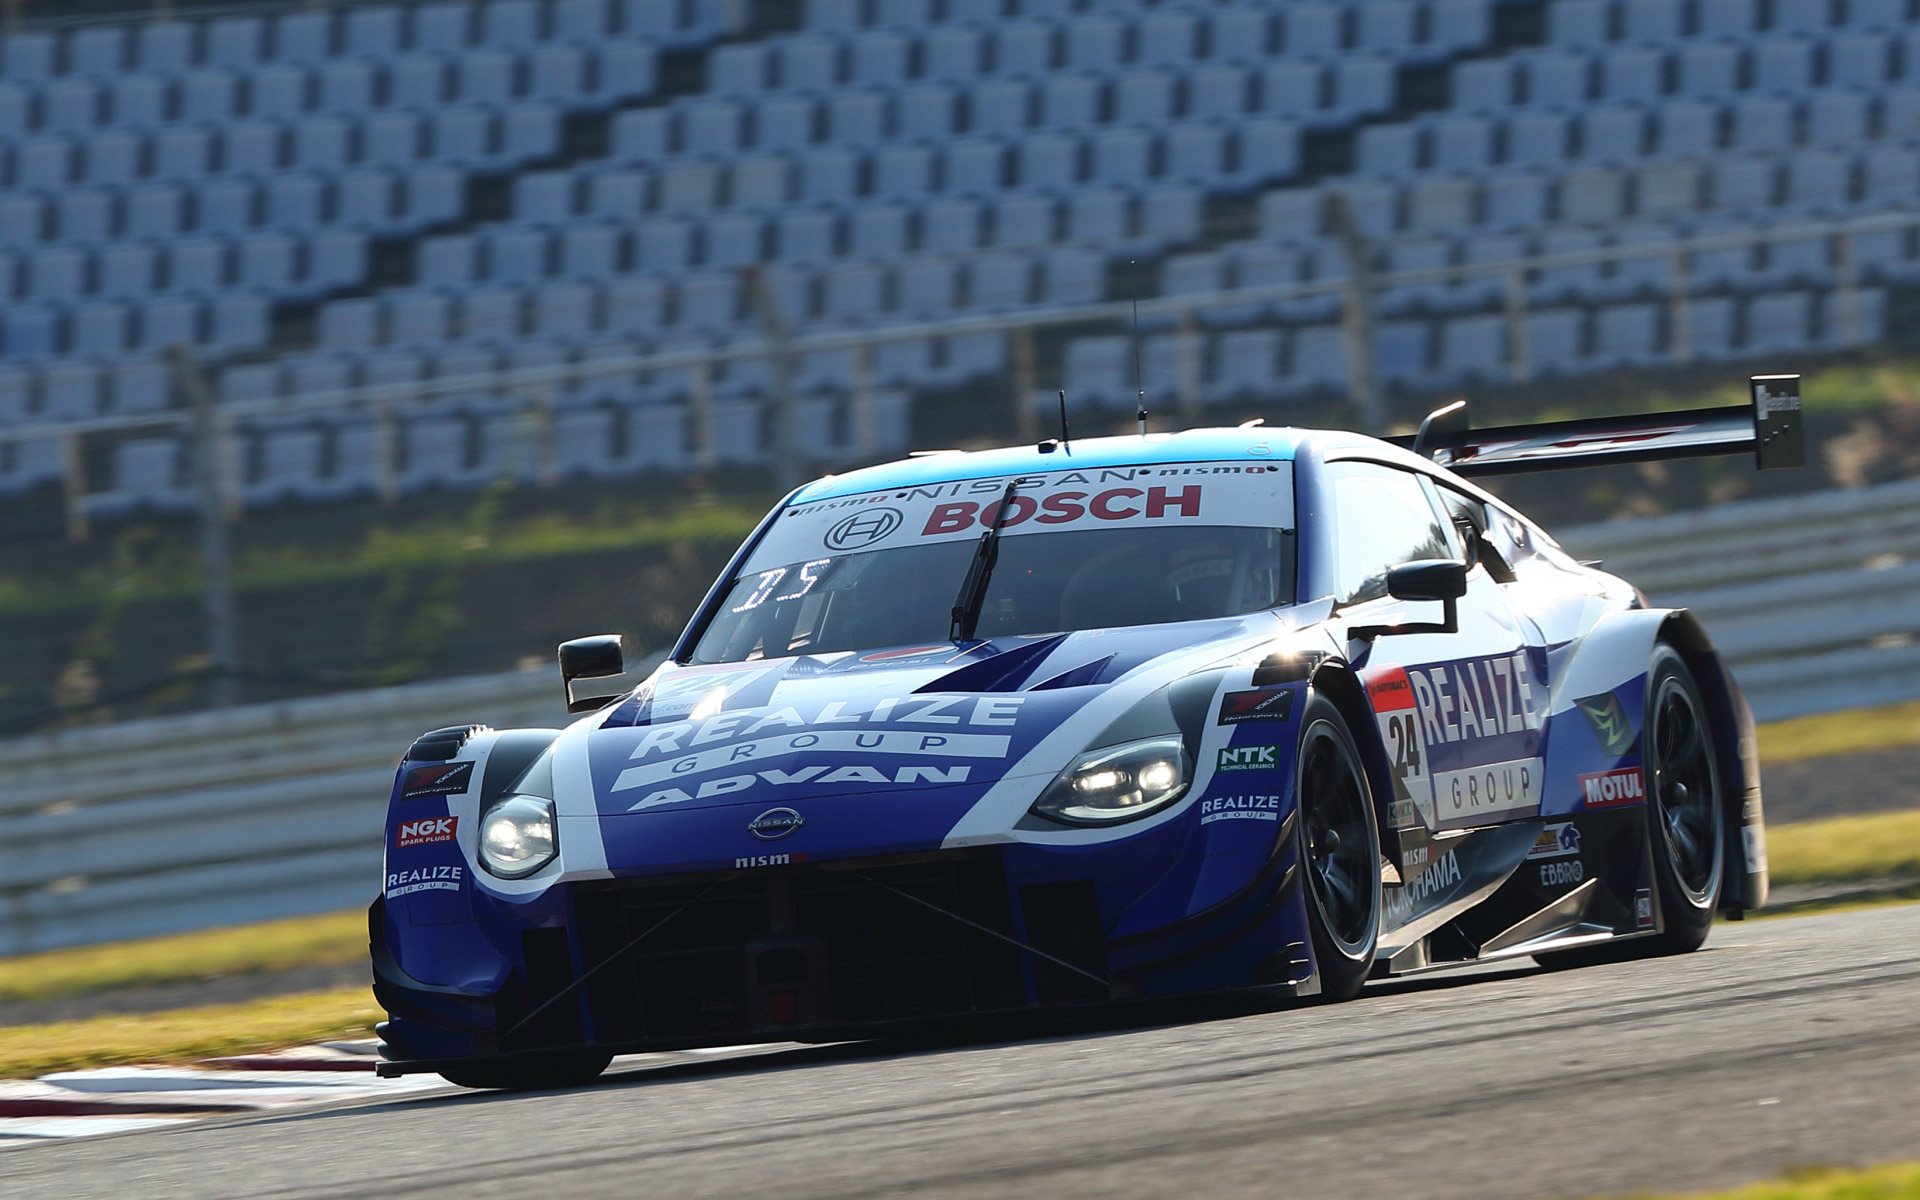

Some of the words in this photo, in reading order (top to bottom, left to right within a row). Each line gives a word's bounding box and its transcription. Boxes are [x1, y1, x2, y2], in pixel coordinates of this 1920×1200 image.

[1159, 466, 1265, 476] nismo
[906, 468, 1136, 502] NISSAN
[799, 495, 887, 514] nismo
[921, 485, 1202, 536] BOSCH
[1255, 690, 1290, 710] YOKOHAMA
[1409, 654, 1539, 746] REALIZE
[628, 695, 1026, 760] REALIZE
[672, 732, 948, 774] GROUP
[1221, 745, 1276, 765] NTK
[1389, 714, 1421, 779] 24
[435, 763, 469, 785] YOKOHAMA
[1221, 763, 1248, 771] TECHNICAL
[626, 765, 972, 812] ADVAN
[1451, 766, 1529, 810] GROUP
[1585, 773, 1643, 803] MOTUL
[1201, 795, 1280, 814] REALIZE
[748, 818, 803, 830] NISSAN
[1210, 811, 1266, 821] GROUP
[401, 818, 453, 839] NGK
[400, 838, 424, 847] SPARK
[426, 835, 451, 843] PLUGS
[735, 852, 807, 869] nismo
[387, 866, 462, 887] REALIZE
[1540, 860, 1584, 887] EBBRO
[396, 883, 449, 895] GROUP
